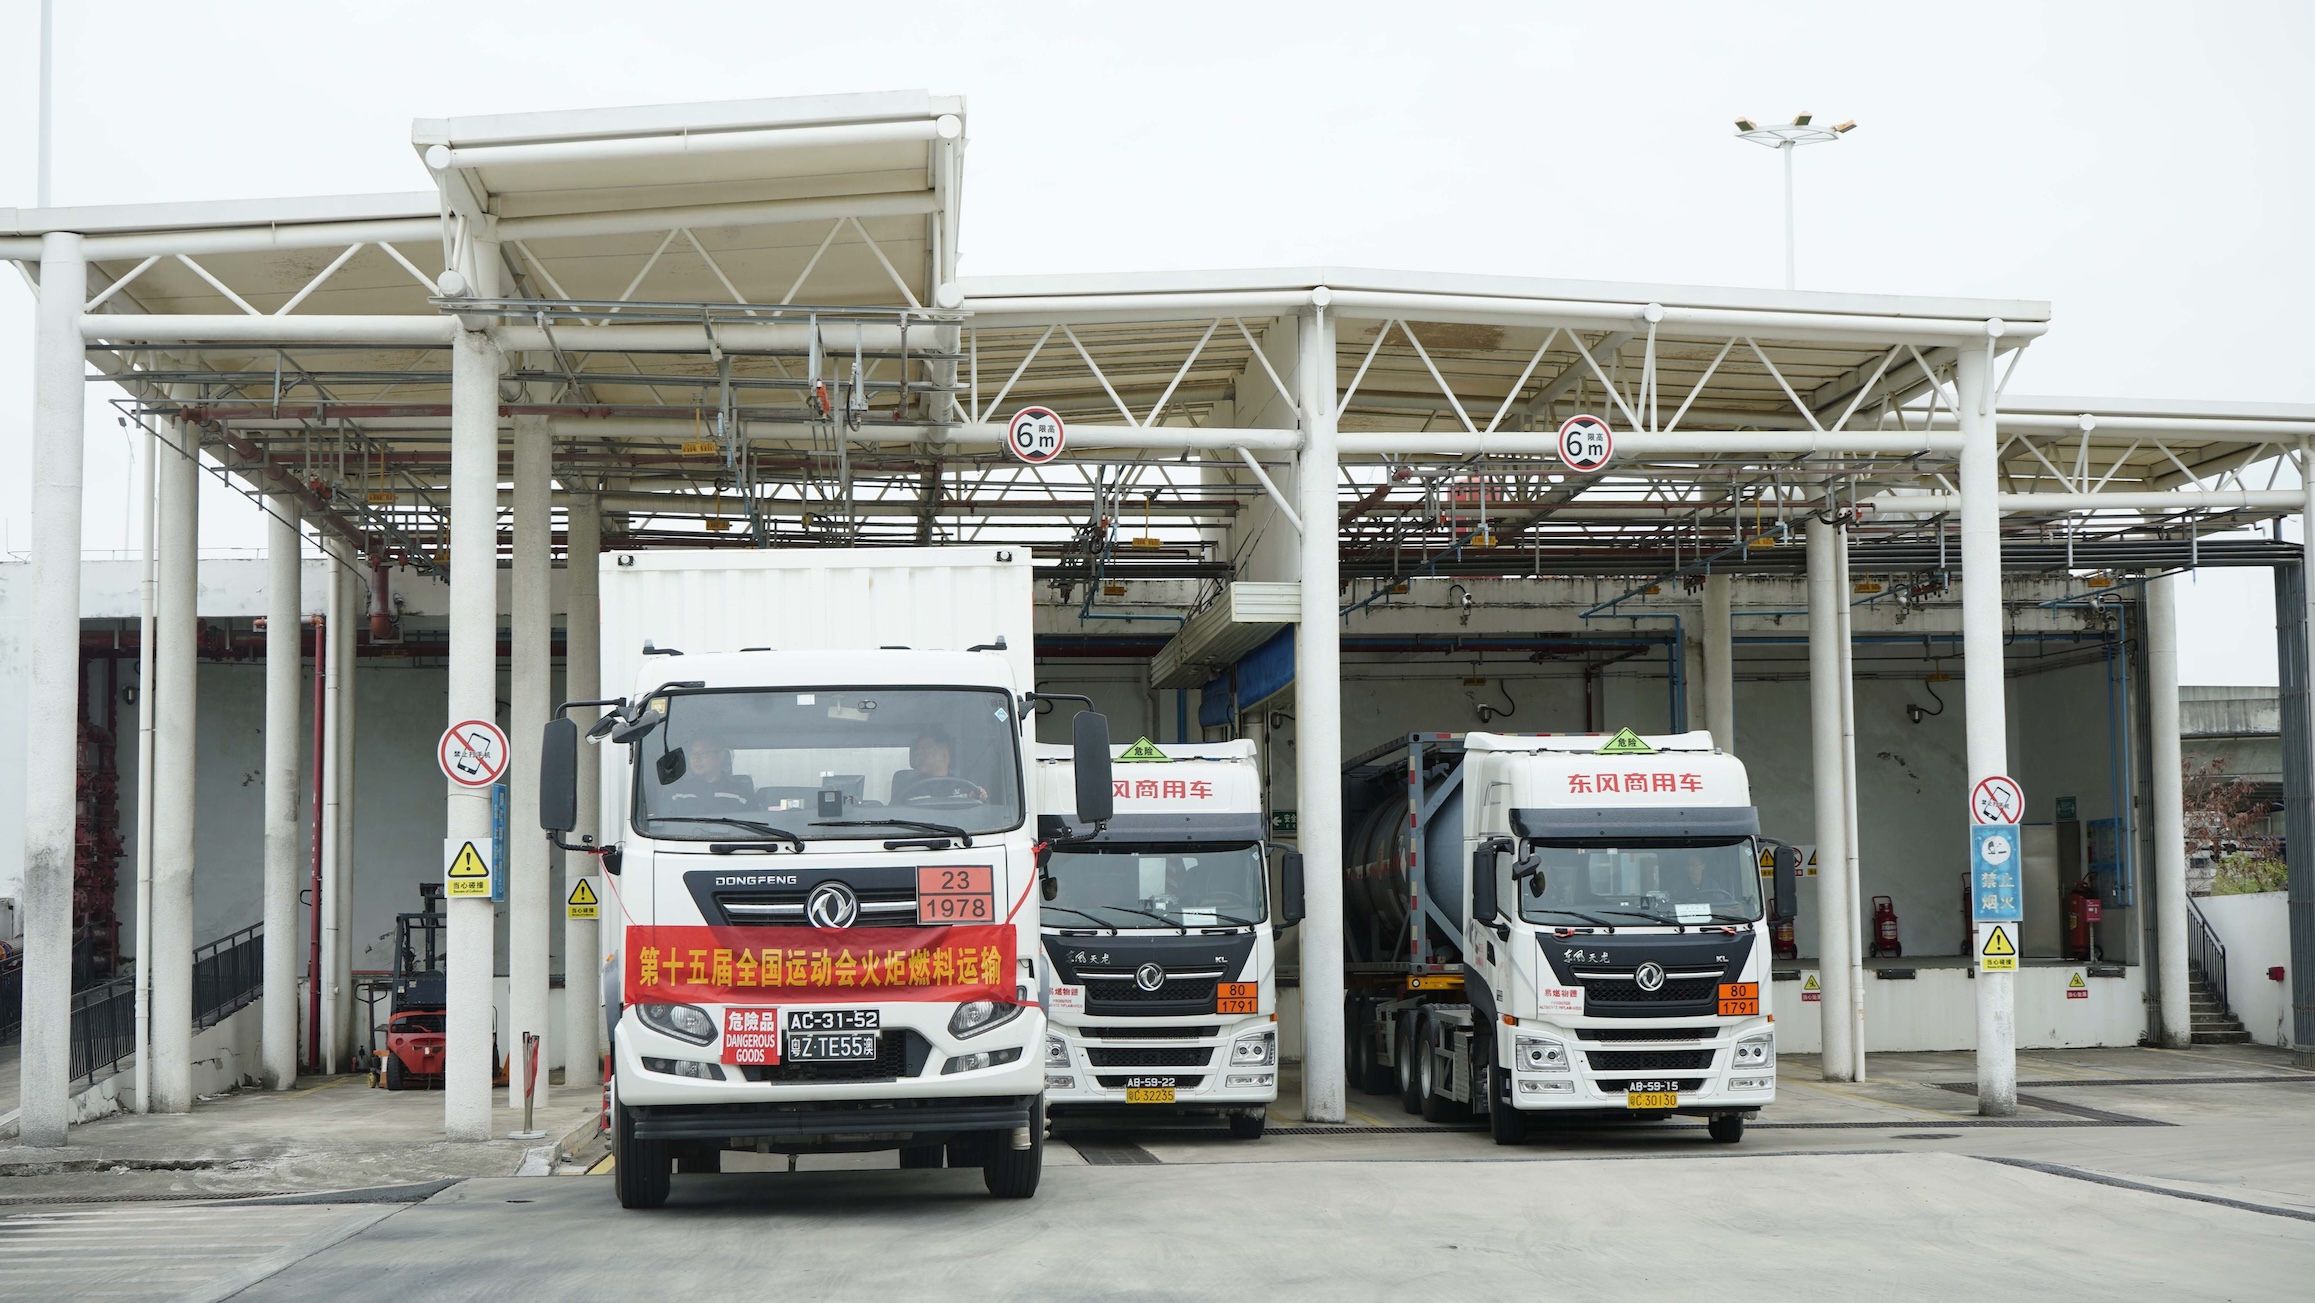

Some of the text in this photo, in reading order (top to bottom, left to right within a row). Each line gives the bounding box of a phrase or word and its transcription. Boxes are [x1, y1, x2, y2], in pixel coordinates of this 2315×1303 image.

[1017, 422, 1054, 448] 6 m
[1039, 425, 1055, 433] 限高
[1566, 431, 1603, 456] 6 m
[1587, 433, 1603, 441] 限高
[1617, 738, 1637, 747] 危险
[1134, 746, 1153, 756] 危险
[1567, 772, 1704, 794] 东风商用车
[715, 875, 797, 886] DONGFENG
[941, 870, 970, 890] 23
[1981, 872, 2015, 888] 禁止
[926, 898, 986, 918] 1978
[1981, 894, 2015, 910] 烟火
[1716, 955, 1729, 963] KL
[639, 945, 1002, 988] 第十五届全国运动会火炬燃料运输
[1229, 984, 1246, 996] 80
[1731, 985, 1747, 997] 80
[1222, 1000, 1253, 1012] 1791
[1724, 1001, 1754, 1014] 1791
[728, 1011, 775, 1032] 危險品
[791, 1012, 878, 1030] AC-31-52
[726, 1034, 775, 1049] DANGEROUS
[736, 1049, 765, 1063] GOODS
[1127, 1077, 1176, 1087] AB-59-22
[1629, 1081, 1679, 1091] AB-59-15
